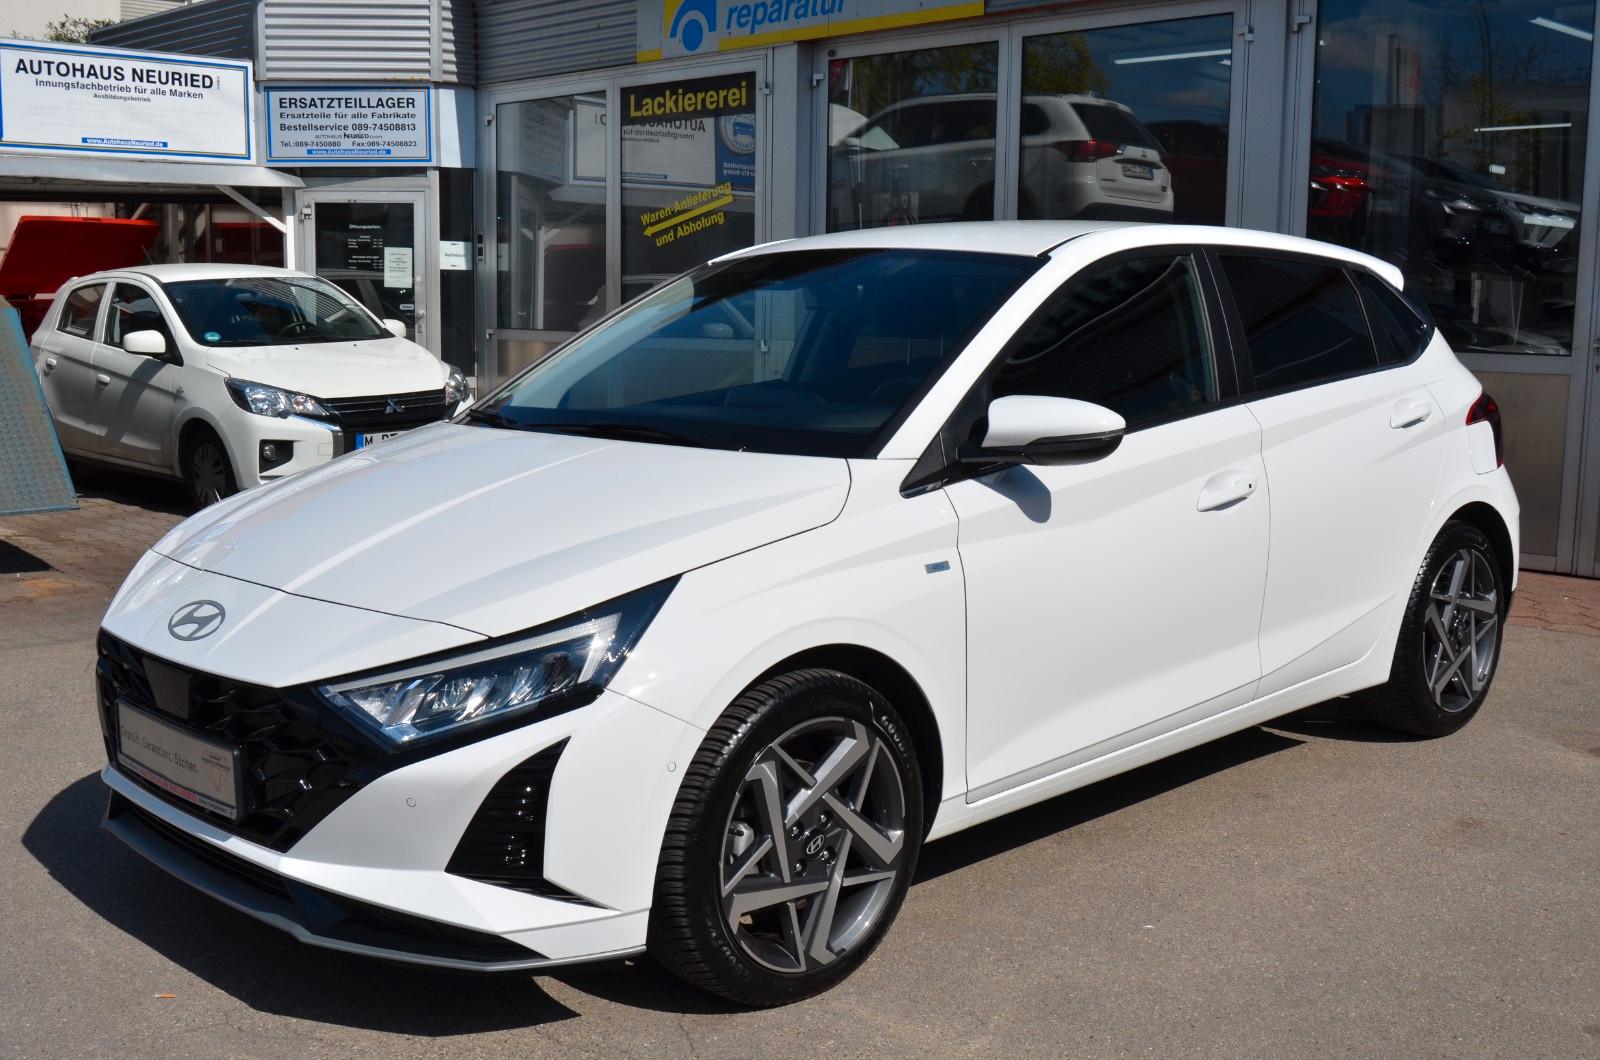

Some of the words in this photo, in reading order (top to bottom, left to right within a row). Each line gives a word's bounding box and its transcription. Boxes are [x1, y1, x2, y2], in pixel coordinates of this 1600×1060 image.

[726, 0, 844, 35] reparatur
[15, 58, 126, 82] AUTOHAUS
[131, 67, 214, 90] NEURIED
[35, 78, 132, 94] Innungsfachbetrieb
[134, 85, 148, 96] für
[150, 86, 167, 97] alle
[169, 88, 204, 100] Marken
[93, 92, 152, 103] Ausbildungsbetrieb
[629, 80, 747, 118] Lackiererei
[279, 97, 416, 109] ERSATZTEILLAGER
[279, 111, 331, 120] Ersatzteile
[334, 111, 348, 120] für
[351, 111, 368, 120] alle
[371, 111, 416, 120] Fabrikate
[279, 123, 349, 131] Bestellservice
[351, 123, 416, 131] 089-74508813
[640, 181, 732, 226] Waren-Anlieferung
[655, 229, 675, 247] und
[676, 211, 725, 240] Abholung
